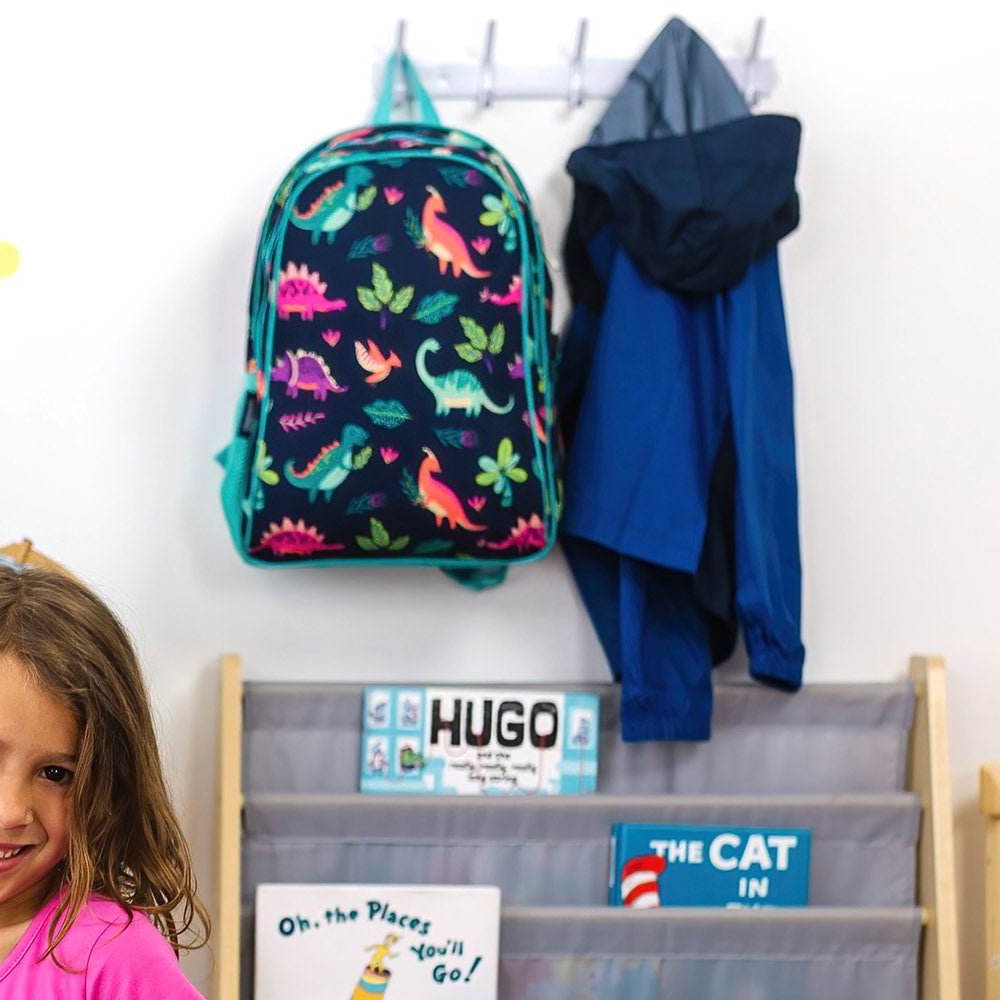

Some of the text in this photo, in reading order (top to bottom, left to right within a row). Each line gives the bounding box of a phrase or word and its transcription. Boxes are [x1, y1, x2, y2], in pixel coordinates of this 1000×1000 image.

[430, 699, 558, 749] HUGO
[650, 833, 798, 871] THE CAT
[739, 877, 769, 898] IN
[325, 907, 358, 924] the
[367, 901, 431, 935] Places
[410, 940, 463, 961] You'll
[432, 956, 482, 984] Go!
